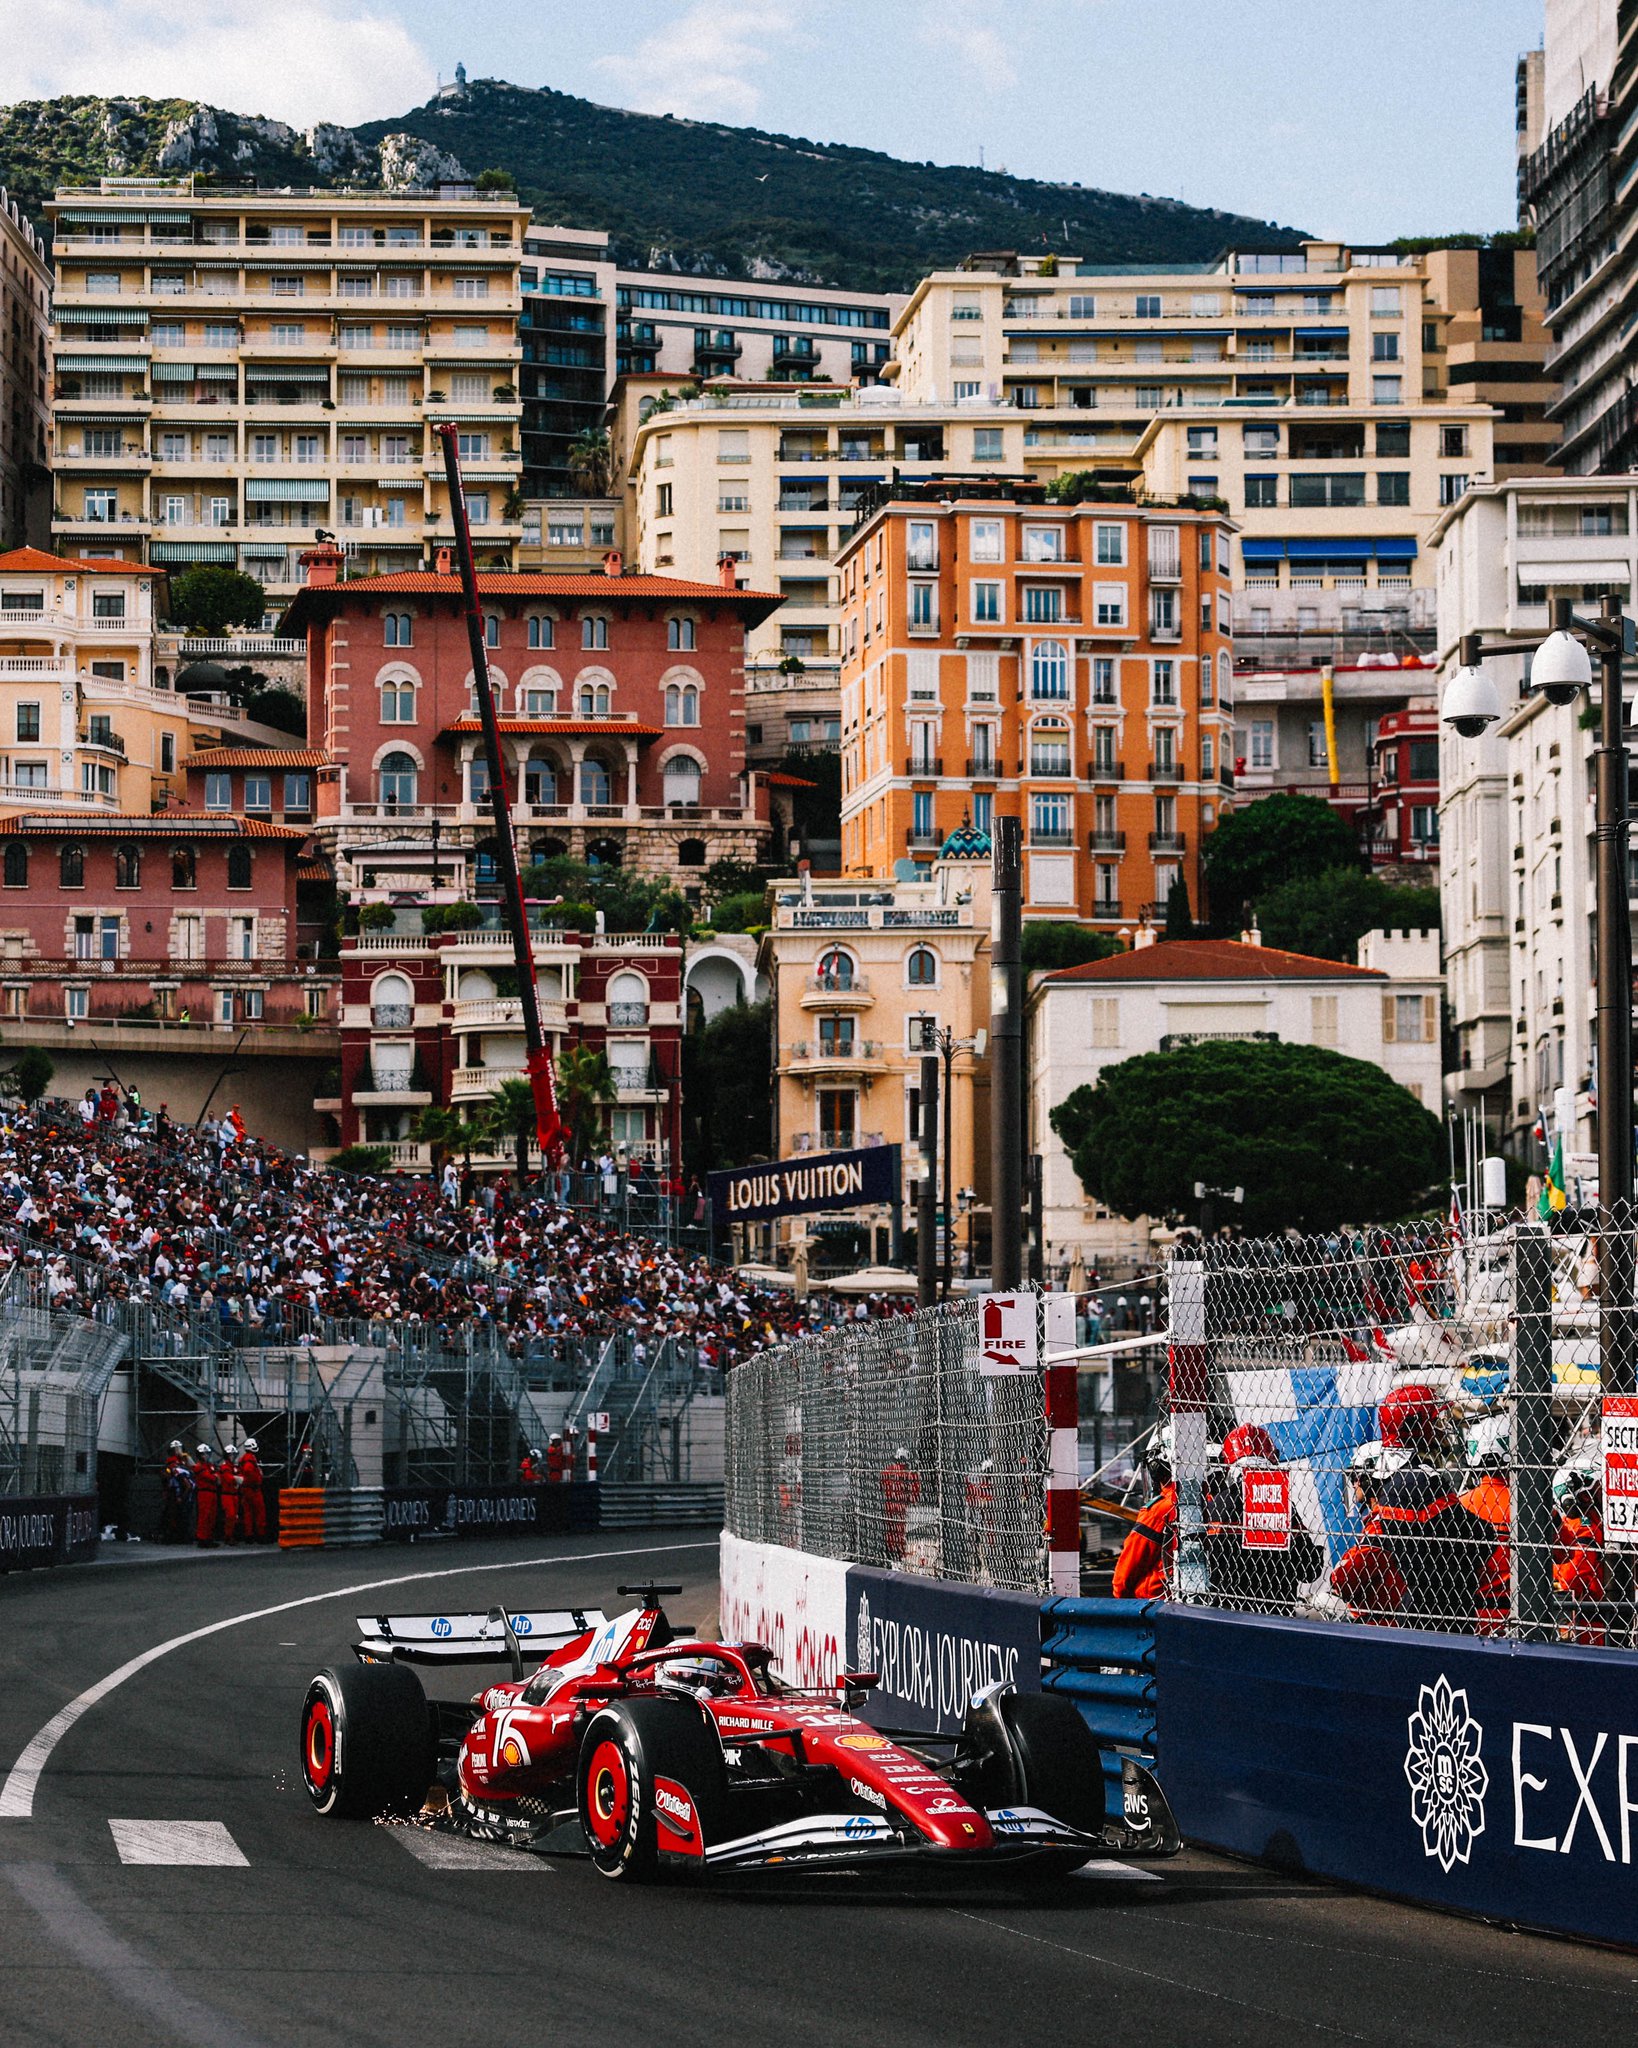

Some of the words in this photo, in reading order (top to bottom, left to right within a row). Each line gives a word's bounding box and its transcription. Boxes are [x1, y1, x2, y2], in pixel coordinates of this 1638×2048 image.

[729, 1172, 781, 1211] LOUIS
[785, 1160, 863, 1202] VUITTON
[984, 1340, 1027, 1350] FIRE
[1609, 1502, 1628, 1526] 13
[433, 1618, 450, 1637] hp
[514, 1616, 530, 1634] hp
[872, 1616, 935, 1709] EXPLORA
[718, 1715, 750, 1729] RICHARD
[751, 1719, 775, 1731] MILLE
[796, 1714, 862, 1727] 16
[880, 1765, 926, 1774] IBM
[629, 1760, 641, 1841] ZERO
[1124, 1793, 1149, 1815] aws
